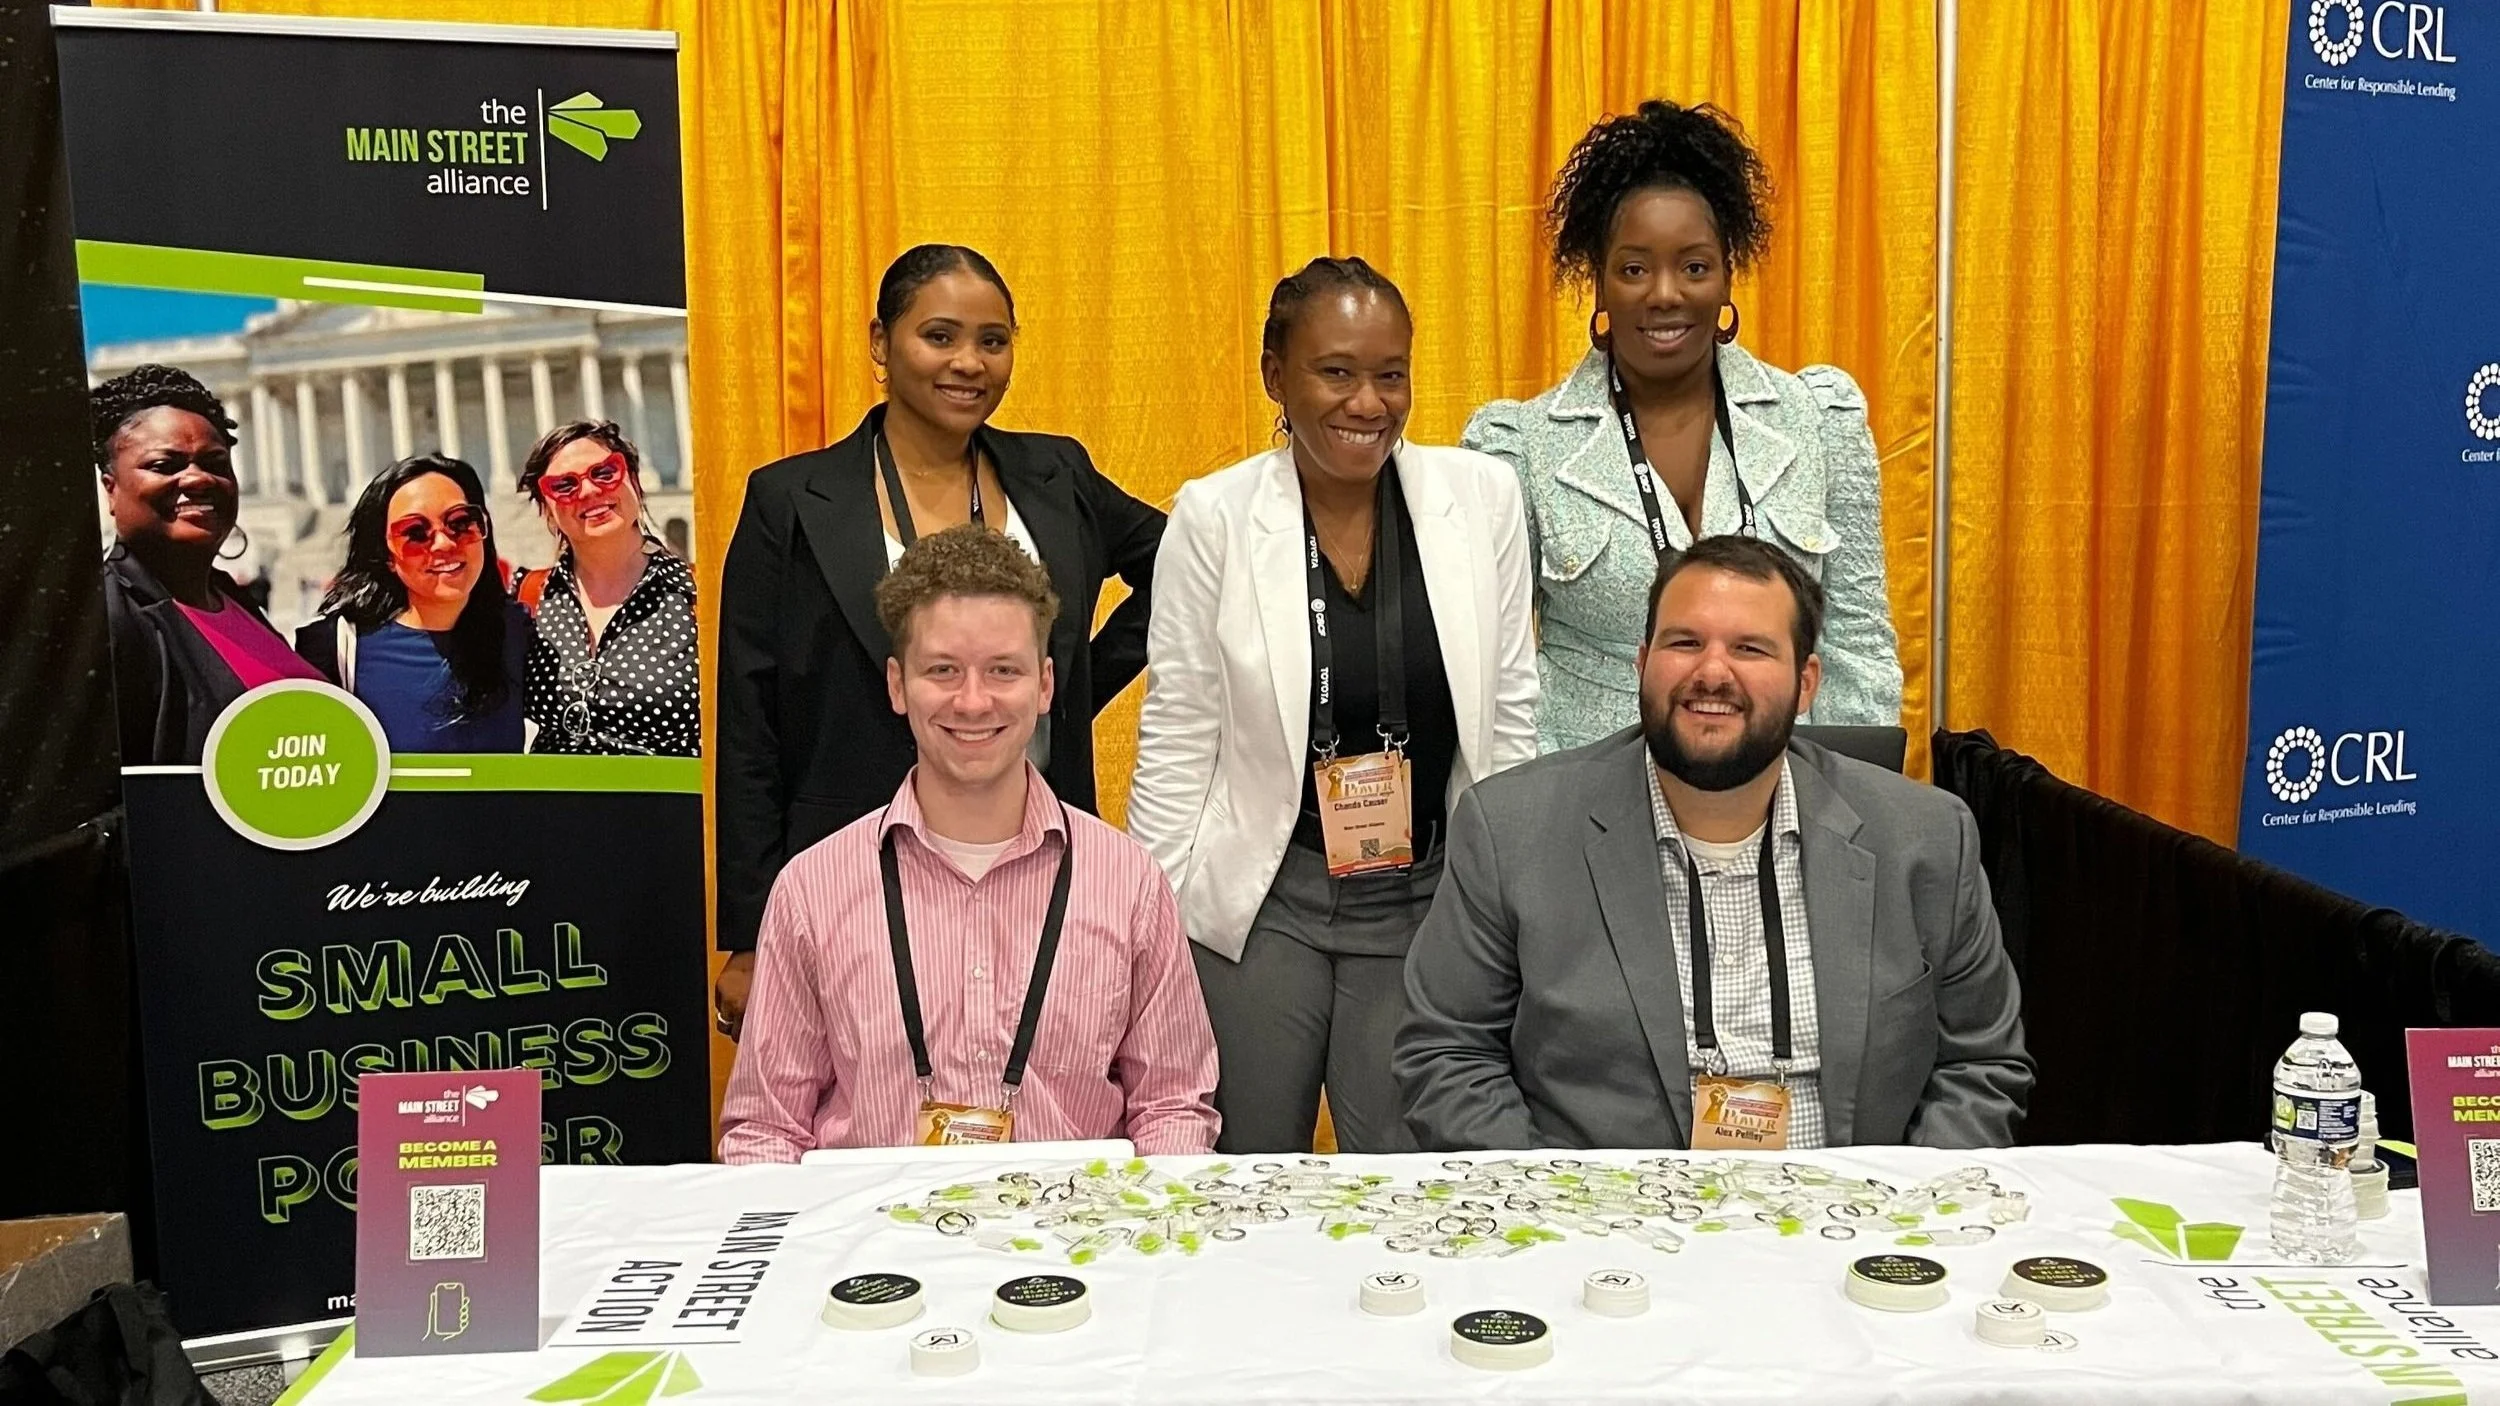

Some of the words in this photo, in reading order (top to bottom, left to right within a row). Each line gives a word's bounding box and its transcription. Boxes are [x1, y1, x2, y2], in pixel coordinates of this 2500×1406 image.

[2372, 1, 2456, 62] CRL
[2305, 74, 2338, 89] Center
[2341, 75, 2356, 90] for
[2358, 77, 2416, 97] Responsible
[2418, 82, 2457, 102] Lending
[480, 98, 527, 124] the
[346, 127, 419, 162] MAIN
[427, 129, 529, 165] STREET
[426, 168, 530, 195] alliance
[1624, 412, 1637, 441] TOYOTA
[2462, 449, 2494, 462] Center
[1651, 518, 1666, 551] TOYOTA
[1309, 536, 1320, 569] TOYOTA
[1320, 666, 1330, 705] TOYOTA
[268, 734, 326, 760] JOIN
[2331, 730, 2417, 786] CRL
[258, 763, 342, 790] TODAY
[2262, 813, 2300, 827] Center
[2303, 809, 2317, 824] for
[2318, 802, 2374, 824] Responsible
[2376, 800, 2417, 816] Lending
[326, 881, 420, 911] We're
[419, 871, 531, 907] building
[257, 922, 608, 1020] SMALL
[2448, 1056, 2472, 1067] MAIN
[398, 1101, 423, 1114] MAIN
[424, 1100, 460, 1113] STREET
[2453, 1096, 2500, 1107] BECO
[2453, 1109, 2500, 1122] MEM
[399, 1140, 481, 1153] BECOME
[484, 1140, 497, 1150] A
[1714, 1127, 1733, 1138] Alex
[398, 1154, 498, 1169] MEMBER
[716, 1211, 800, 1254] MAIN
[576, 1260, 683, 1333] ACTION
[672, 1260, 770, 1331] STREET
[2198, 1276, 2266, 1310] the
[2251, 1276, 2420, 1358] STREET
[2357, 1277, 2499, 1360] alliance
